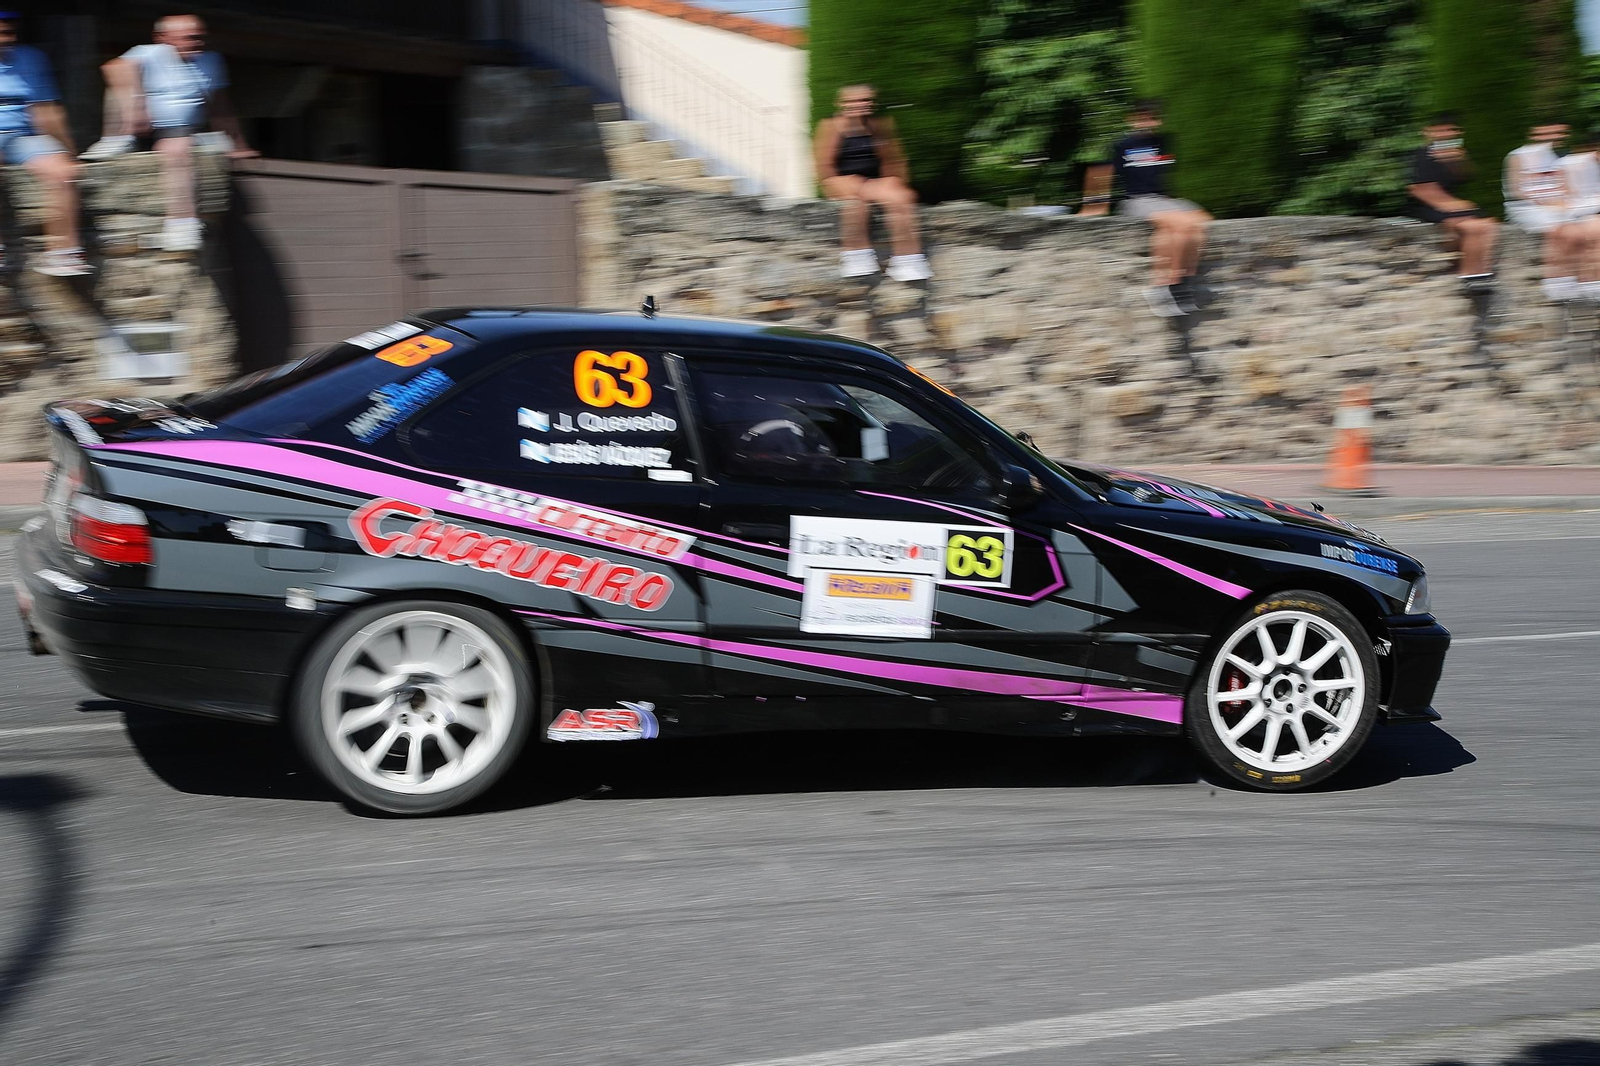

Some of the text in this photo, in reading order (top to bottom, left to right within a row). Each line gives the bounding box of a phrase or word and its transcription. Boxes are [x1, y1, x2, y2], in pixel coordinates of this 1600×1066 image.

[573, 350, 652, 408] 63
[946, 534, 1005, 578] 63
[548, 709, 643, 732] ASR
